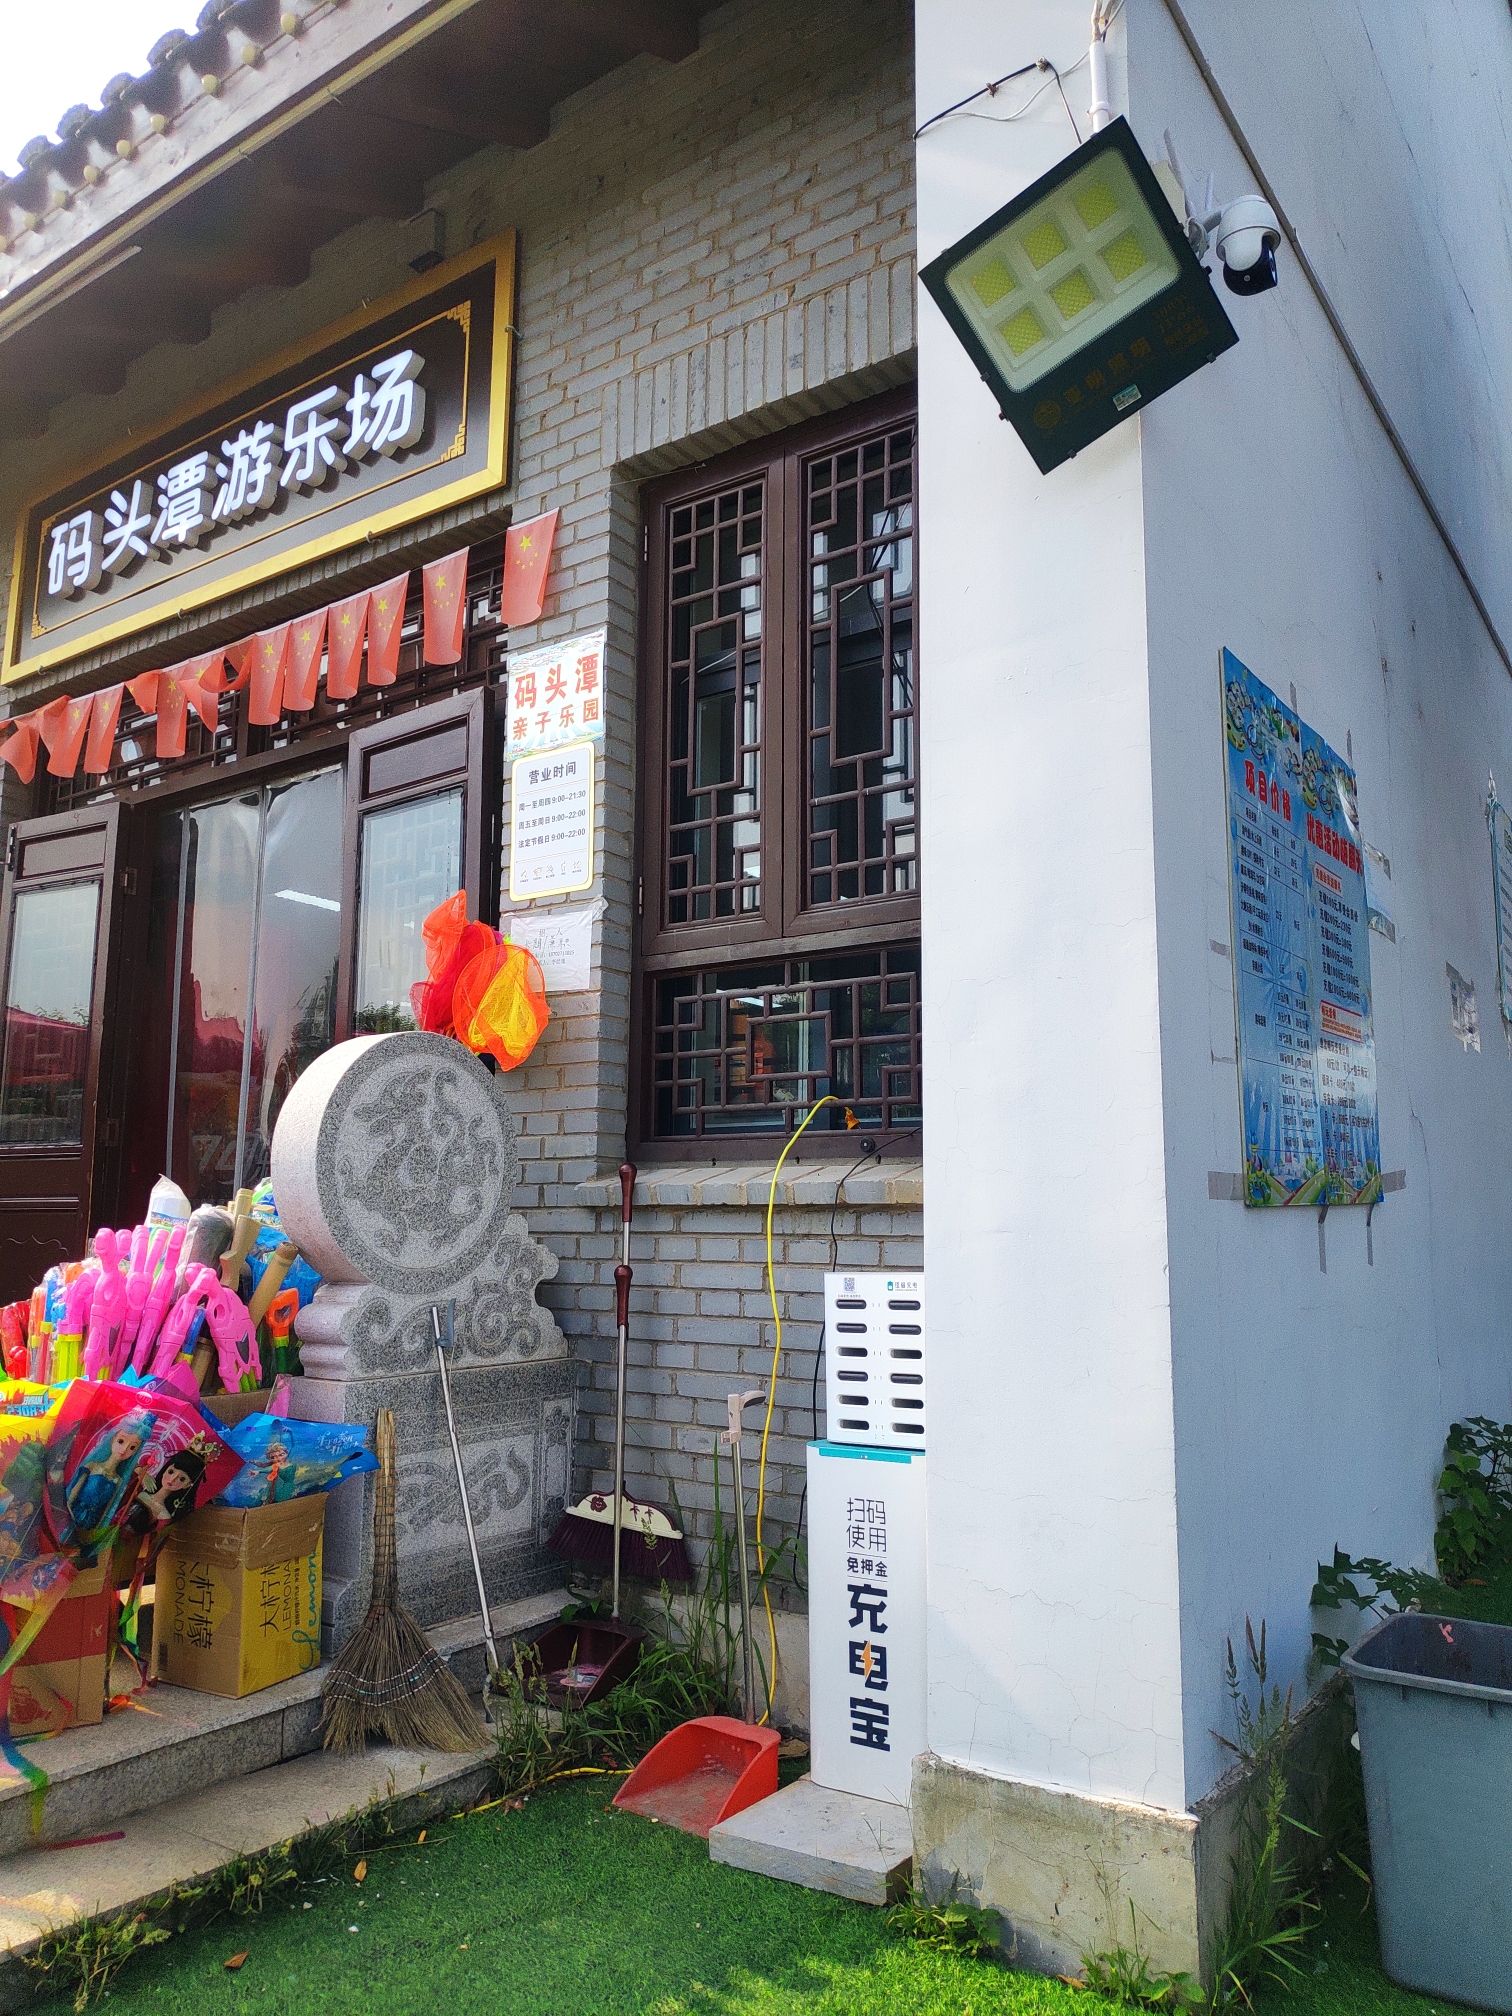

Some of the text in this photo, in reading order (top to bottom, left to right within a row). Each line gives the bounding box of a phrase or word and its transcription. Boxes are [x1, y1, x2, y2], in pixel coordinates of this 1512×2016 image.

[47, 348, 418, 597] 码头潭游乐场
[514, 653, 599, 709] 码头潭
[512, 698, 599, 741] 亲子乐园
[528, 761, 577, 785] 营业时间
[1245, 759, 1291, 821] 项目价格
[846, 1497, 886, 1525] 扫码
[846, 1525, 887, 1553] 使用
[846, 1557, 888, 1578] 免押金
[846, 1583, 891, 1752] 充电宝
